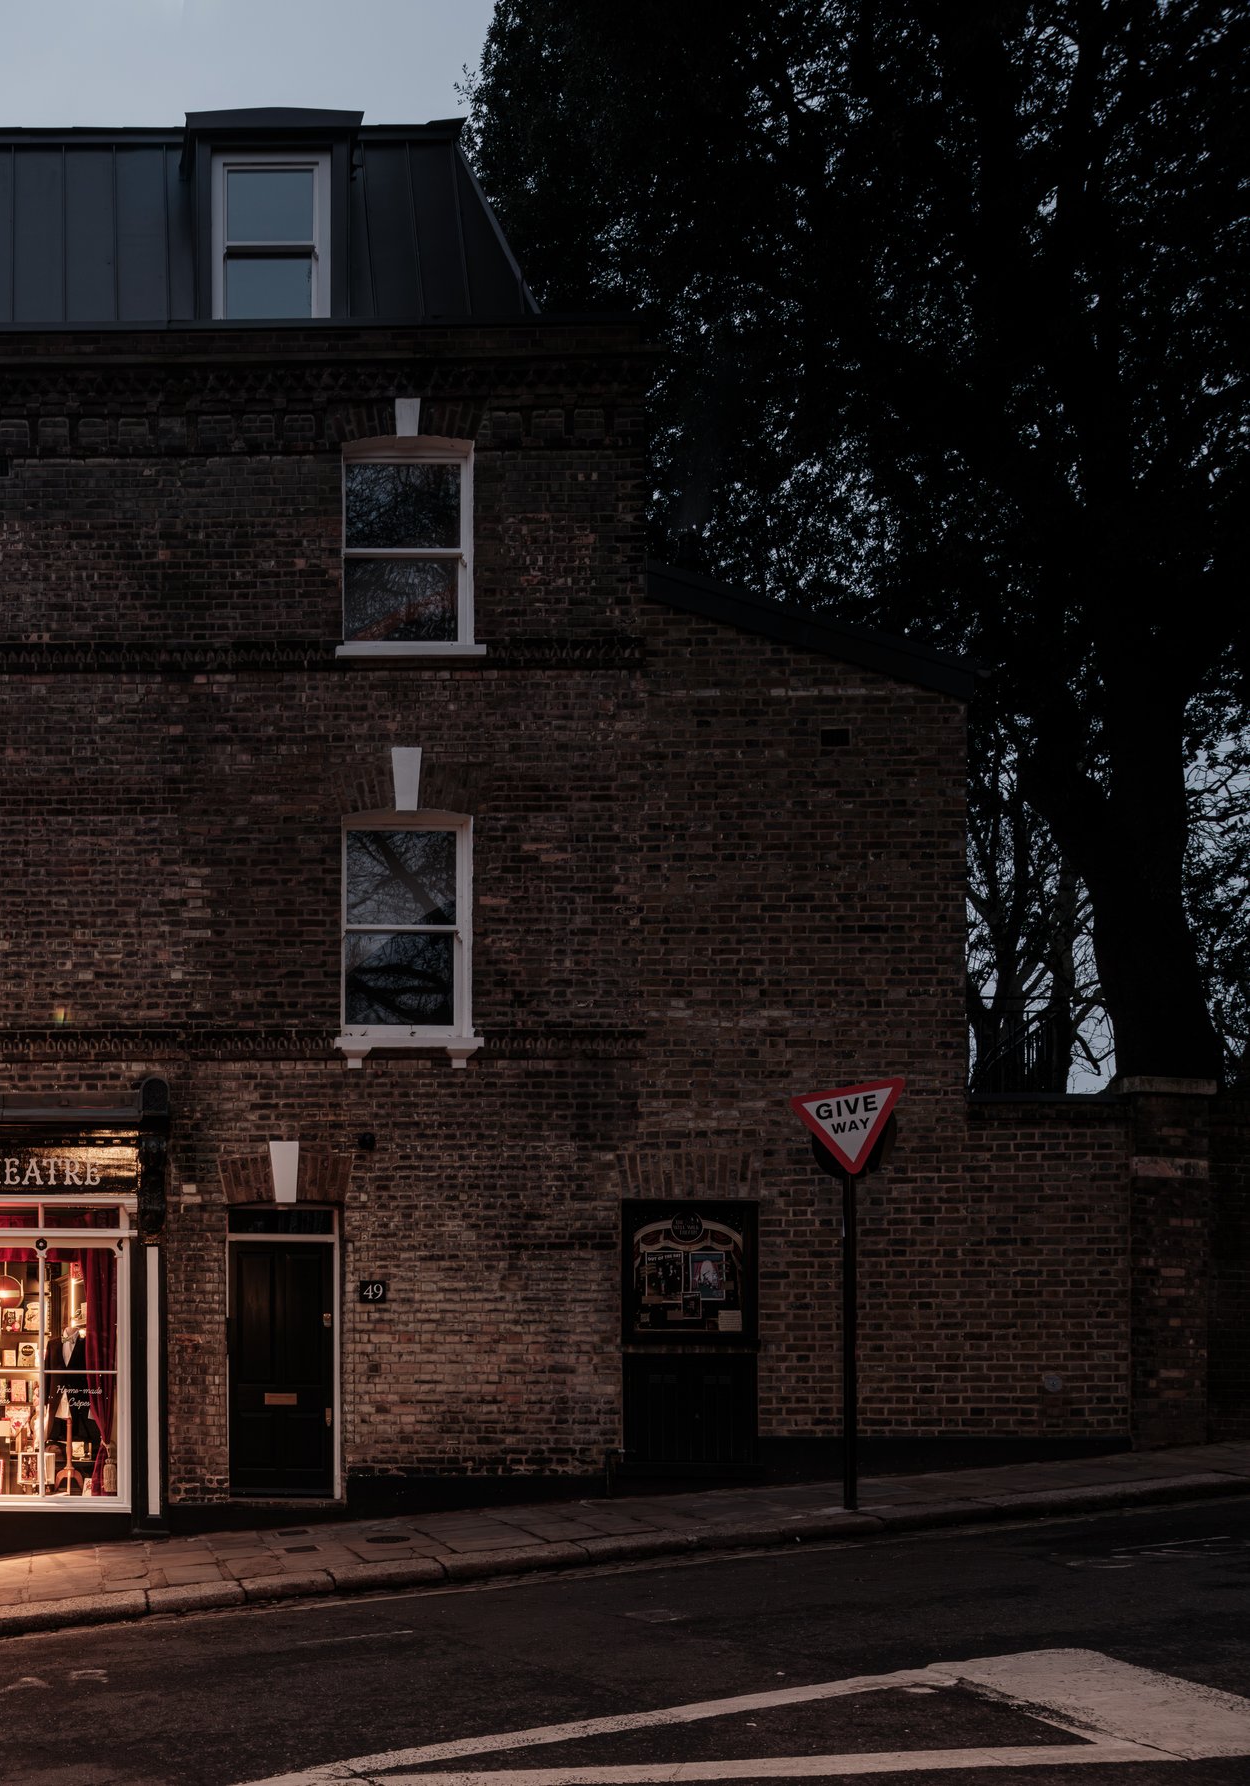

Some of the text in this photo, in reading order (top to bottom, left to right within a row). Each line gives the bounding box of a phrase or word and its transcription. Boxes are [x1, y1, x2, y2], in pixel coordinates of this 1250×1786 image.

[815, 1094, 878, 1120] GIVE
[831, 1117, 870, 1135] WAY
[362, 1283, 384, 1300] 49
[56, 1384, 103, 1395] Home-made
